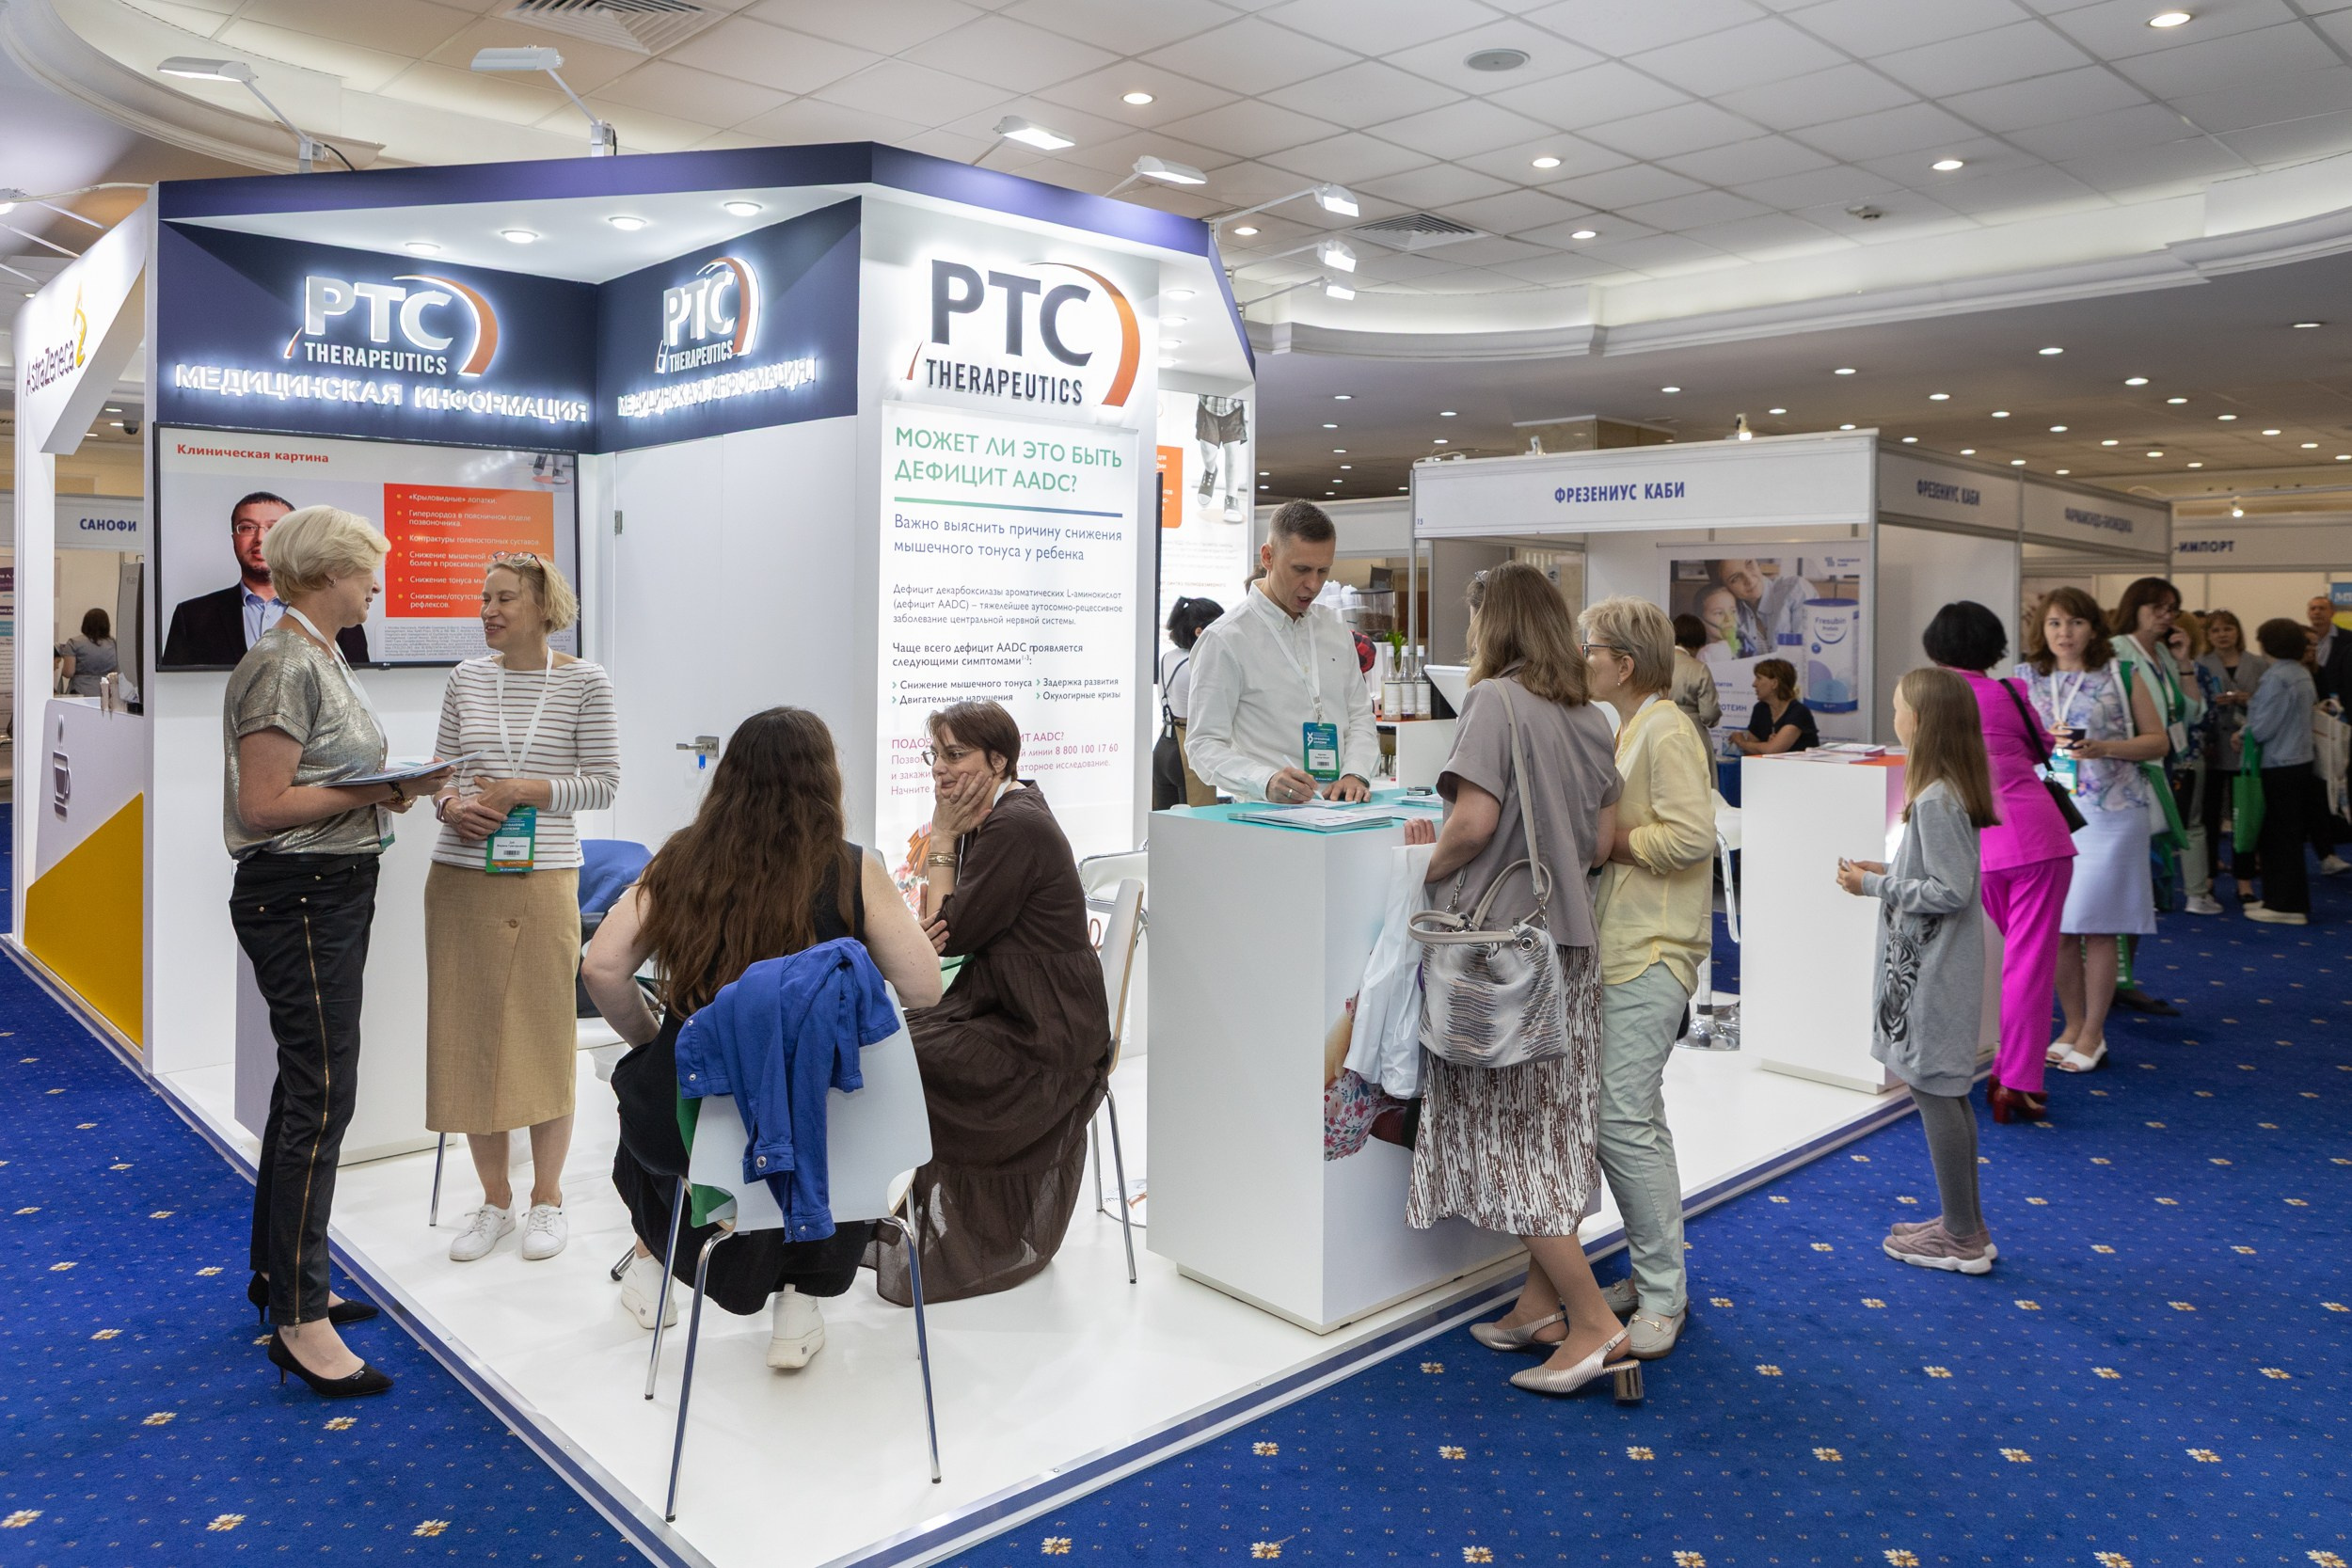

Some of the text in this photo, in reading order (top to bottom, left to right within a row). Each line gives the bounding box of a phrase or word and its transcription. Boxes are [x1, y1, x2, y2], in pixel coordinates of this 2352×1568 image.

[304, 275, 453, 351] PTC
[662, 271, 736, 347] PTC
[931, 259, 1093, 367] PTC
[305, 341, 448, 375] THERAPEUTICS
[669, 340, 734, 372] THERAPEUTICS
[617, 356, 817, 419] МЕДИЦИНСКАЯ ИНФОРМАЦИЯ
[926, 358, 1083, 404] THERAPEUTICS
[176, 364, 590, 423] МЕДИЦИНСКАЯ ИНФОРМАЦИЯ
[177, 444, 329, 464] Клиническая картина
[896, 426, 1122, 467] МОЖЕТ ЛИ ЭТО БЫТЬ
[895, 459, 1008, 487] ДЕФИЦИТ
[1554, 482, 1685, 504] ФРЕЗЕНИУС КАБИ
[409, 510, 456, 519] Гиперлордоз
[79, 518, 137, 531] САНОФИ
[895, 514, 1122, 542] Важно выяснить причину снижения
[409, 534, 454, 544] Контрактуры
[894, 541, 1084, 562] мышечного тонуса у ребенка
[409, 593, 484, 601] Снижение/отсутстви
[893, 583, 1122, 599] Дефицит декарбоксилазы ароматических L-аминокислот
[893, 599, 935, 611] (дефицит
[979, 601, 1029, 610] тяжелейшее
[1031, 604, 1123, 614] аутосомно-рецессивное
[893, 613, 1076, 626] заболевание центральной нервной системы.
[892, 642, 922, 655] Чаще
[924, 644, 952, 653] всего
[954, 641, 993, 656] дефицит
[1028, 644, 1083, 655] проявляется
[892, 657, 959, 669] следующими
[899, 679, 1033, 689] Снижение мышечного тонуса
[1042, 677, 1119, 689] Задержка развития
[899, 694, 1013, 705] Двигательные нарушения
[1042, 691, 1120, 702] Окулогирные кризы
[1720, 704, 1747, 712] ОТЕИН
[1028, 749, 1053, 757] линии
[1055, 746, 1060, 755] 8
[1062, 745, 1078, 754] 800
[1081, 744, 1095, 753] 100
[1098, 743, 1107, 752] 17
[1108, 743, 1119, 752] 60
[891, 754, 925, 765] Позвон
[1056, 759, 1111, 769] исследование.
[899, 771, 930, 780] закажи
[891, 785, 930, 796] Начните
